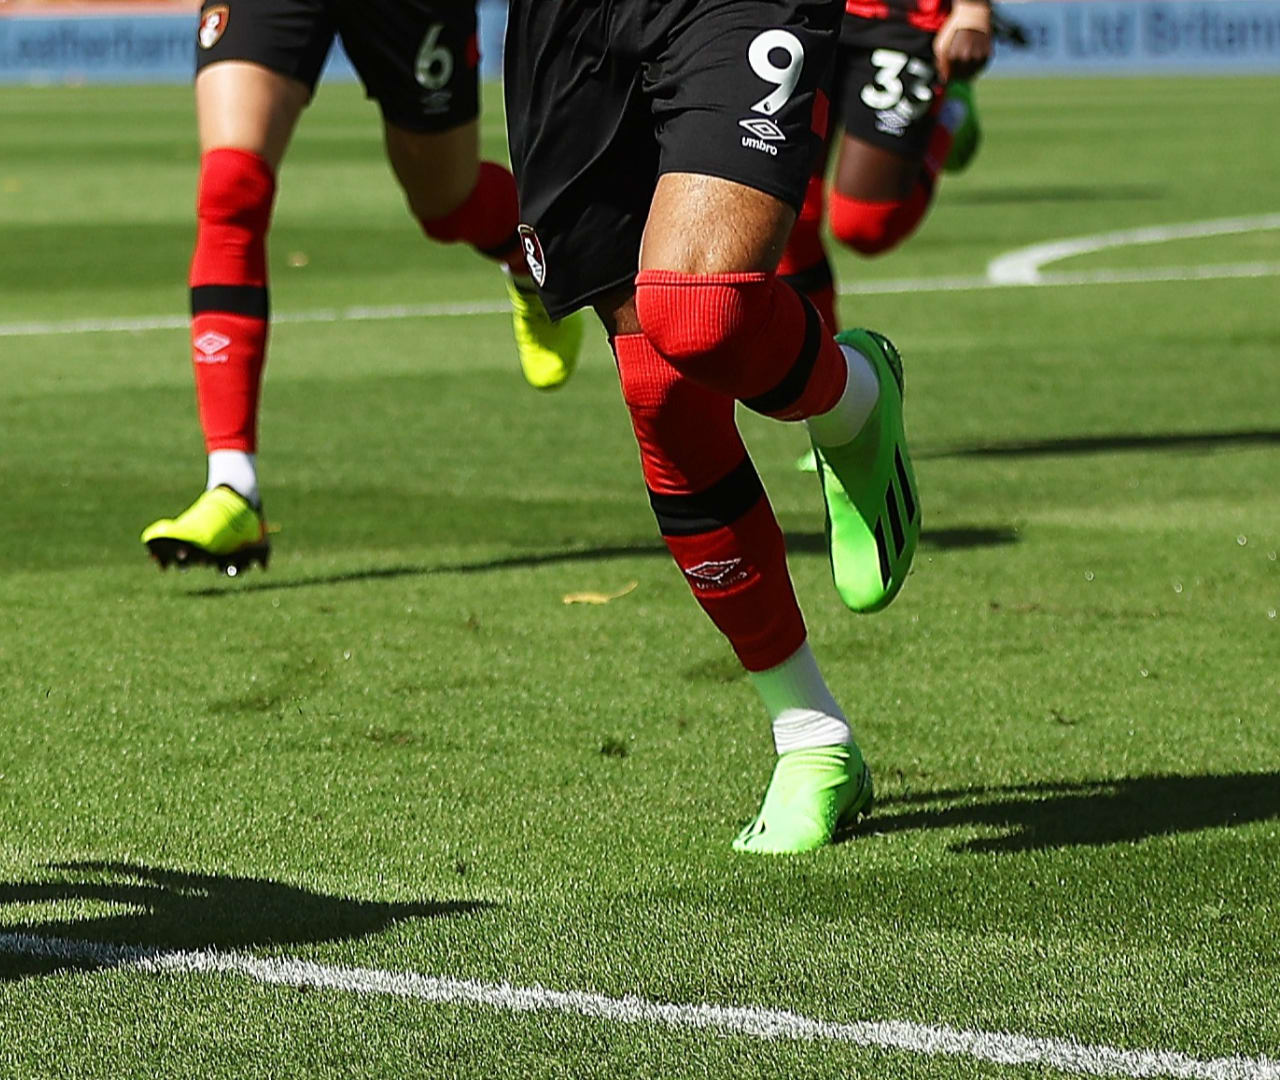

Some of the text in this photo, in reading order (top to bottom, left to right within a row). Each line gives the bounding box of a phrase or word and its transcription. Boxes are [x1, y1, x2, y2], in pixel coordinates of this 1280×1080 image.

[415, 23, 453, 89] 6
[748, 29, 804, 115] 9
[741, 135, 777, 156] umbro
